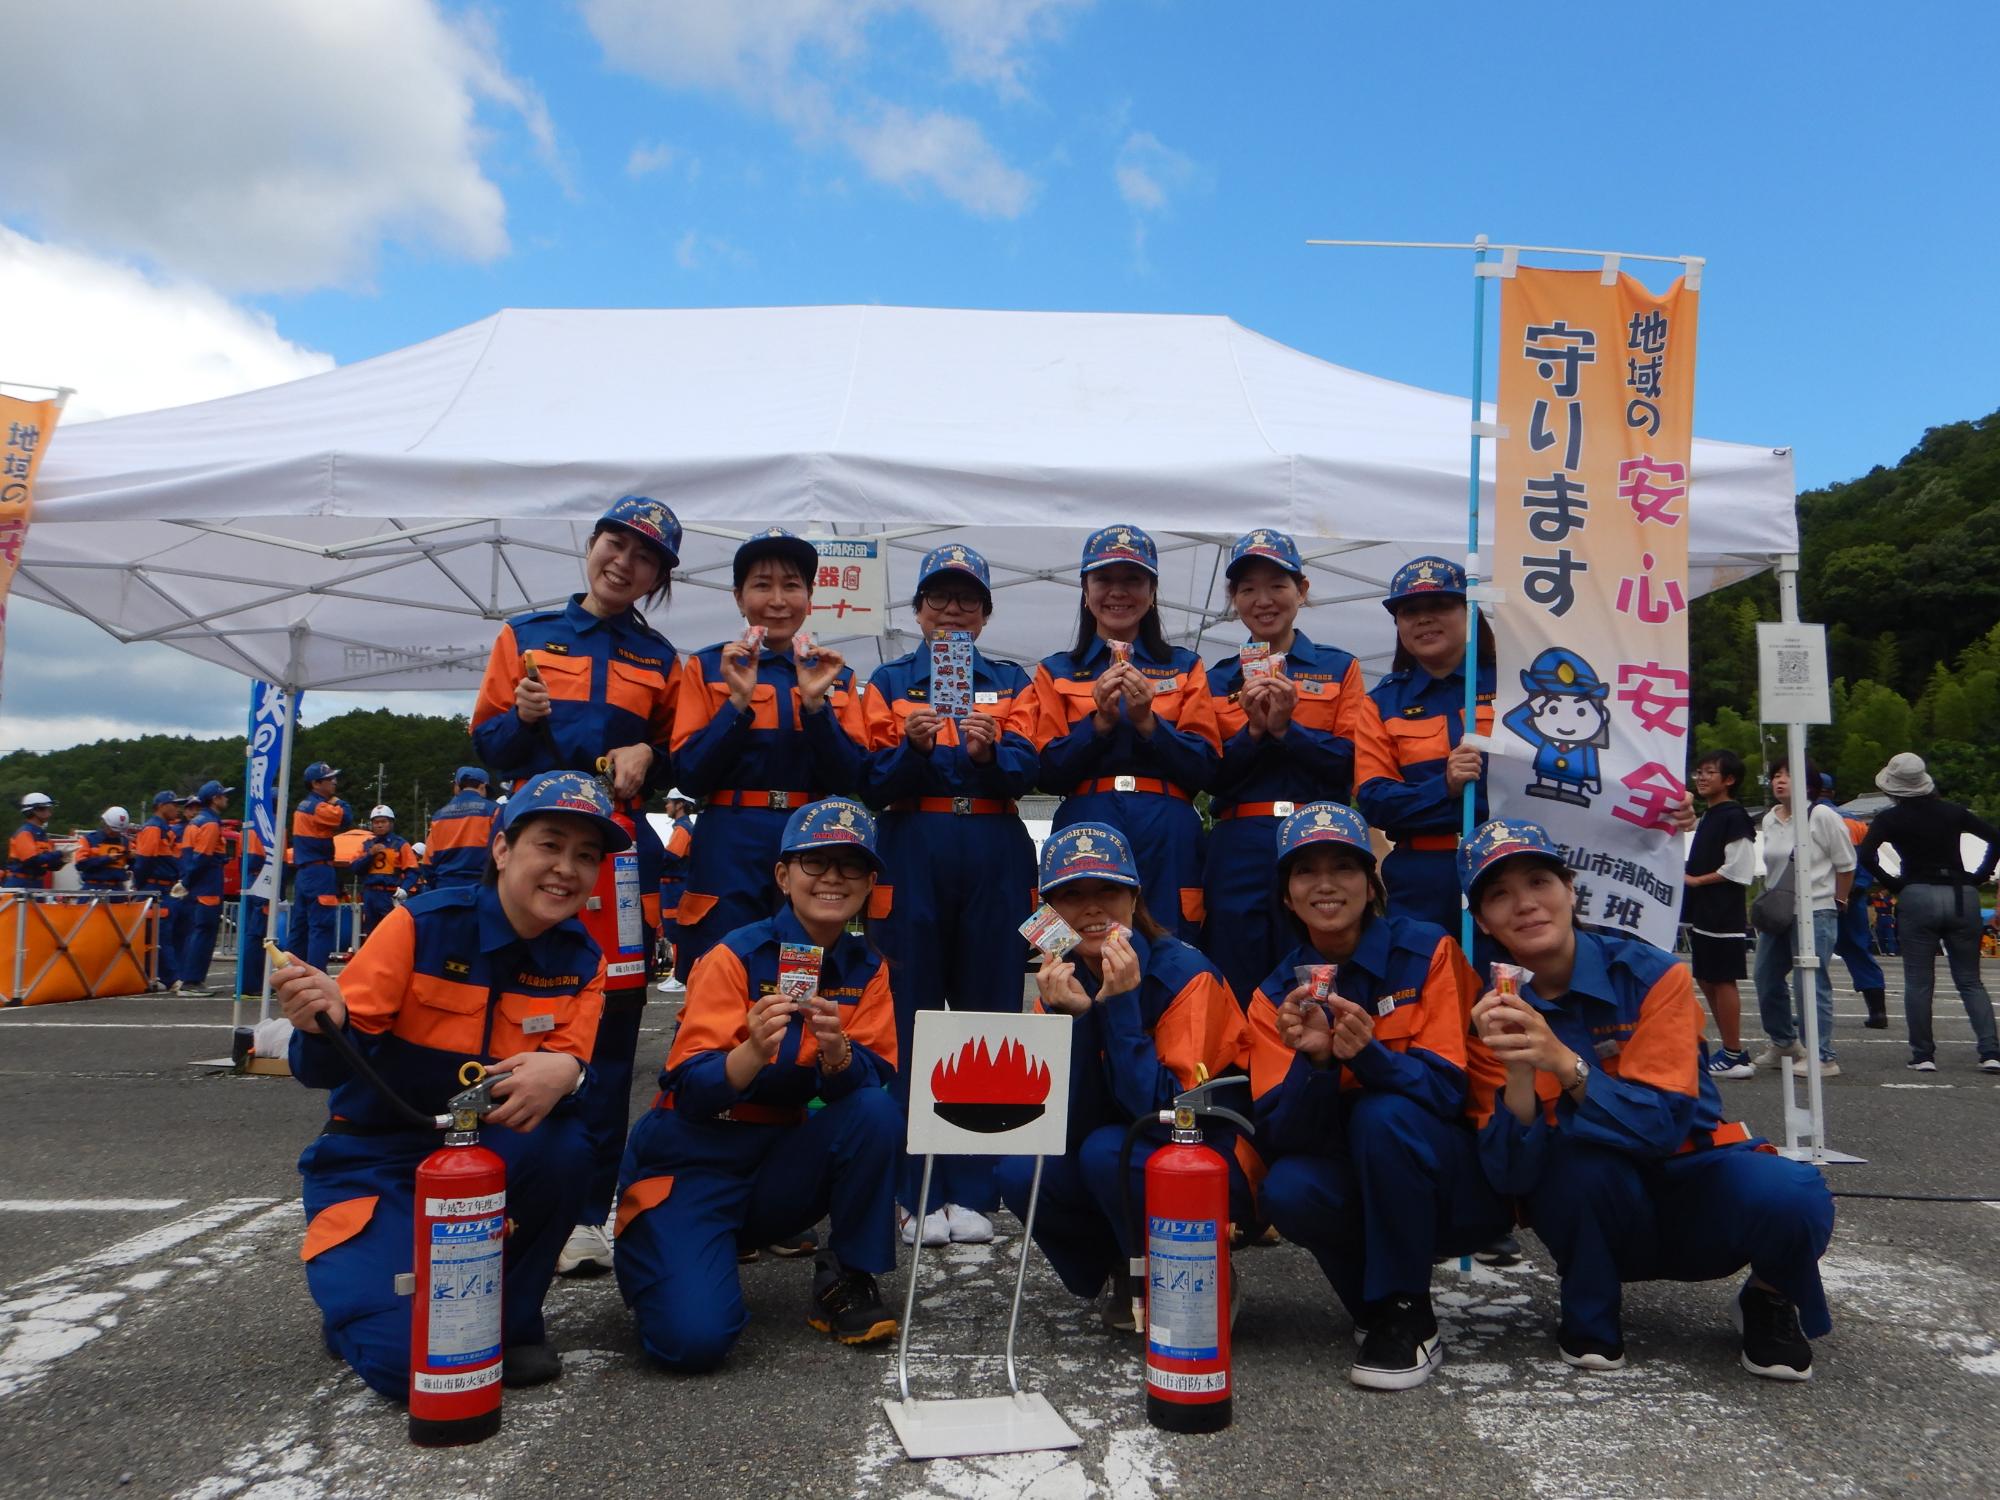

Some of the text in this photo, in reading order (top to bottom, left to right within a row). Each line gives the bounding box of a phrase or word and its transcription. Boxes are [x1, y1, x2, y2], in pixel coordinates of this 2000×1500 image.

[1522, 321, 1596, 618] 守ります
[813, 566, 840, 588] 器
[1611, 311, 1689, 837] 地域の安心安全
[807, 599, 871, 618] ーナー
[820, 802, 867, 819] FIGHTING
[1294, 805, 1346, 819] FIGHTING
[1058, 829, 1107, 845] FIGHTING
